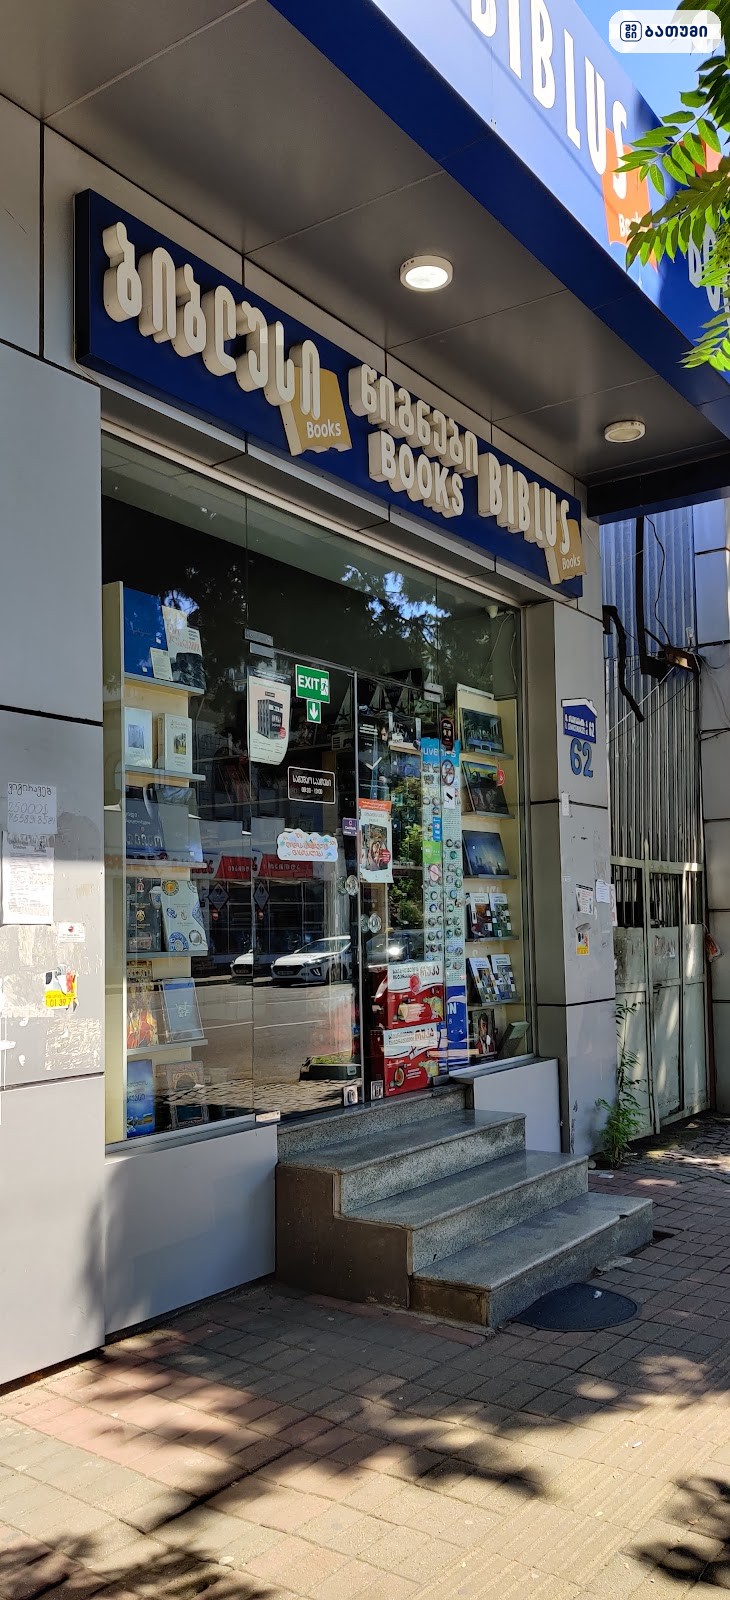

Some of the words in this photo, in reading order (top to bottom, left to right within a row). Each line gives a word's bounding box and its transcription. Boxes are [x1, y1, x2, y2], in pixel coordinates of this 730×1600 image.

[471, 0, 627, 200] IBLUS
[103, 222, 320, 421] ბიბლუსი
[306, 421, 342, 439] Books
[348, 363, 479, 478] წიგნები
[368, 430, 464, 519] BOOKS
[477, 452, 571, 556] BIBLUS
[562, 554, 581, 571] Books
[298, 675, 320, 691] EXIT
[570, 738, 593, 777] 62
